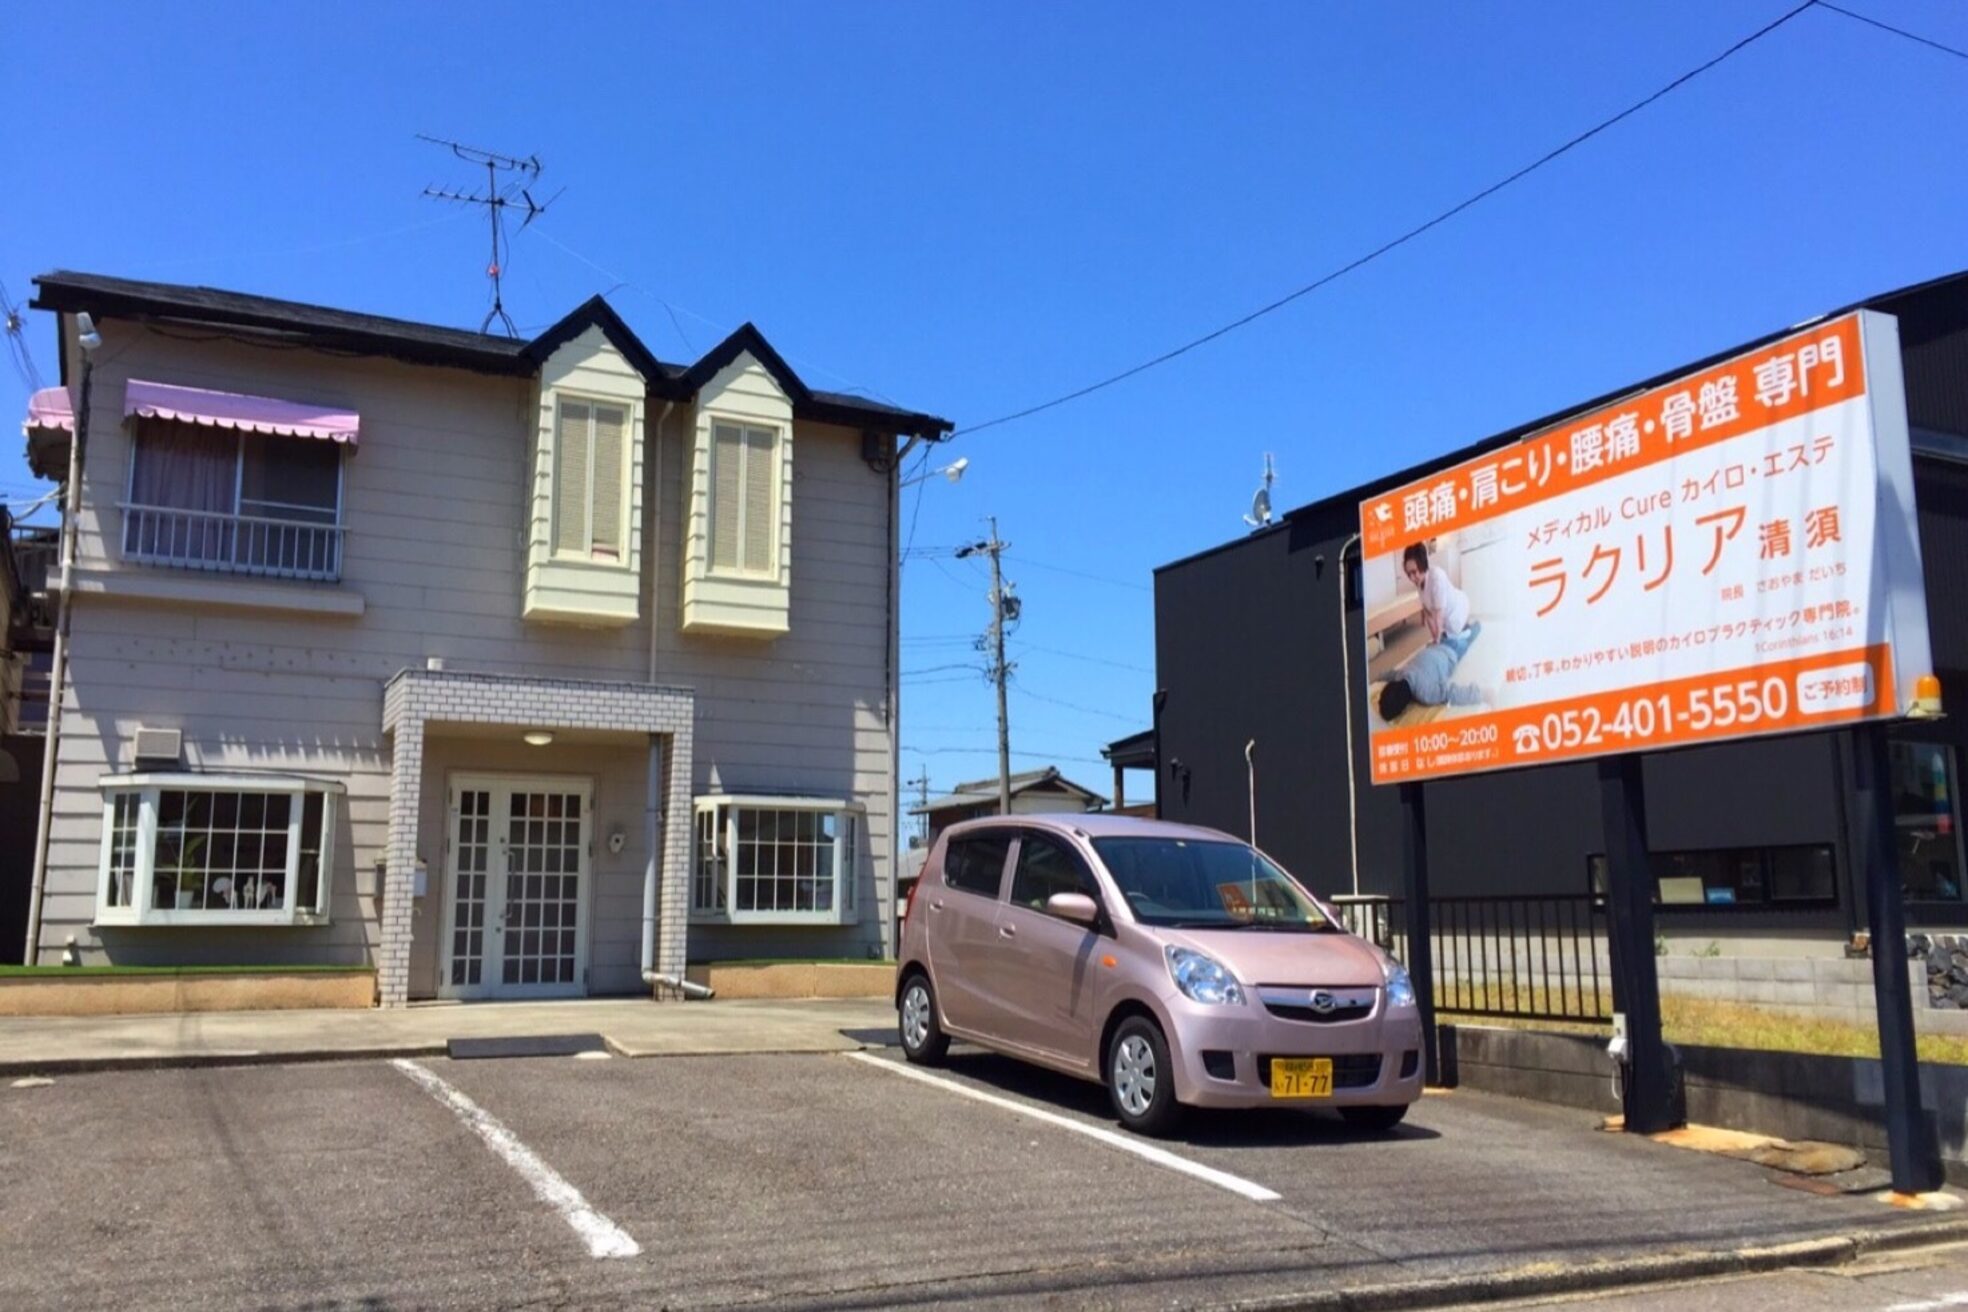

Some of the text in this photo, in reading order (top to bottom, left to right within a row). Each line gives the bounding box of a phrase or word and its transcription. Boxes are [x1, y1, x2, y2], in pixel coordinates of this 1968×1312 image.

[1403, 335, 1845, 533] 頭痛・肩こり・腰痛・骨盤 専門
[1526, 435, 1835, 551] メディカル Cure カイロ・エステ
[1527, 504, 1843, 619] ラクリア 清須
[1542, 676, 1789, 752] 052-401-5550
[1803, 674, 1868, 701] ご予約制
